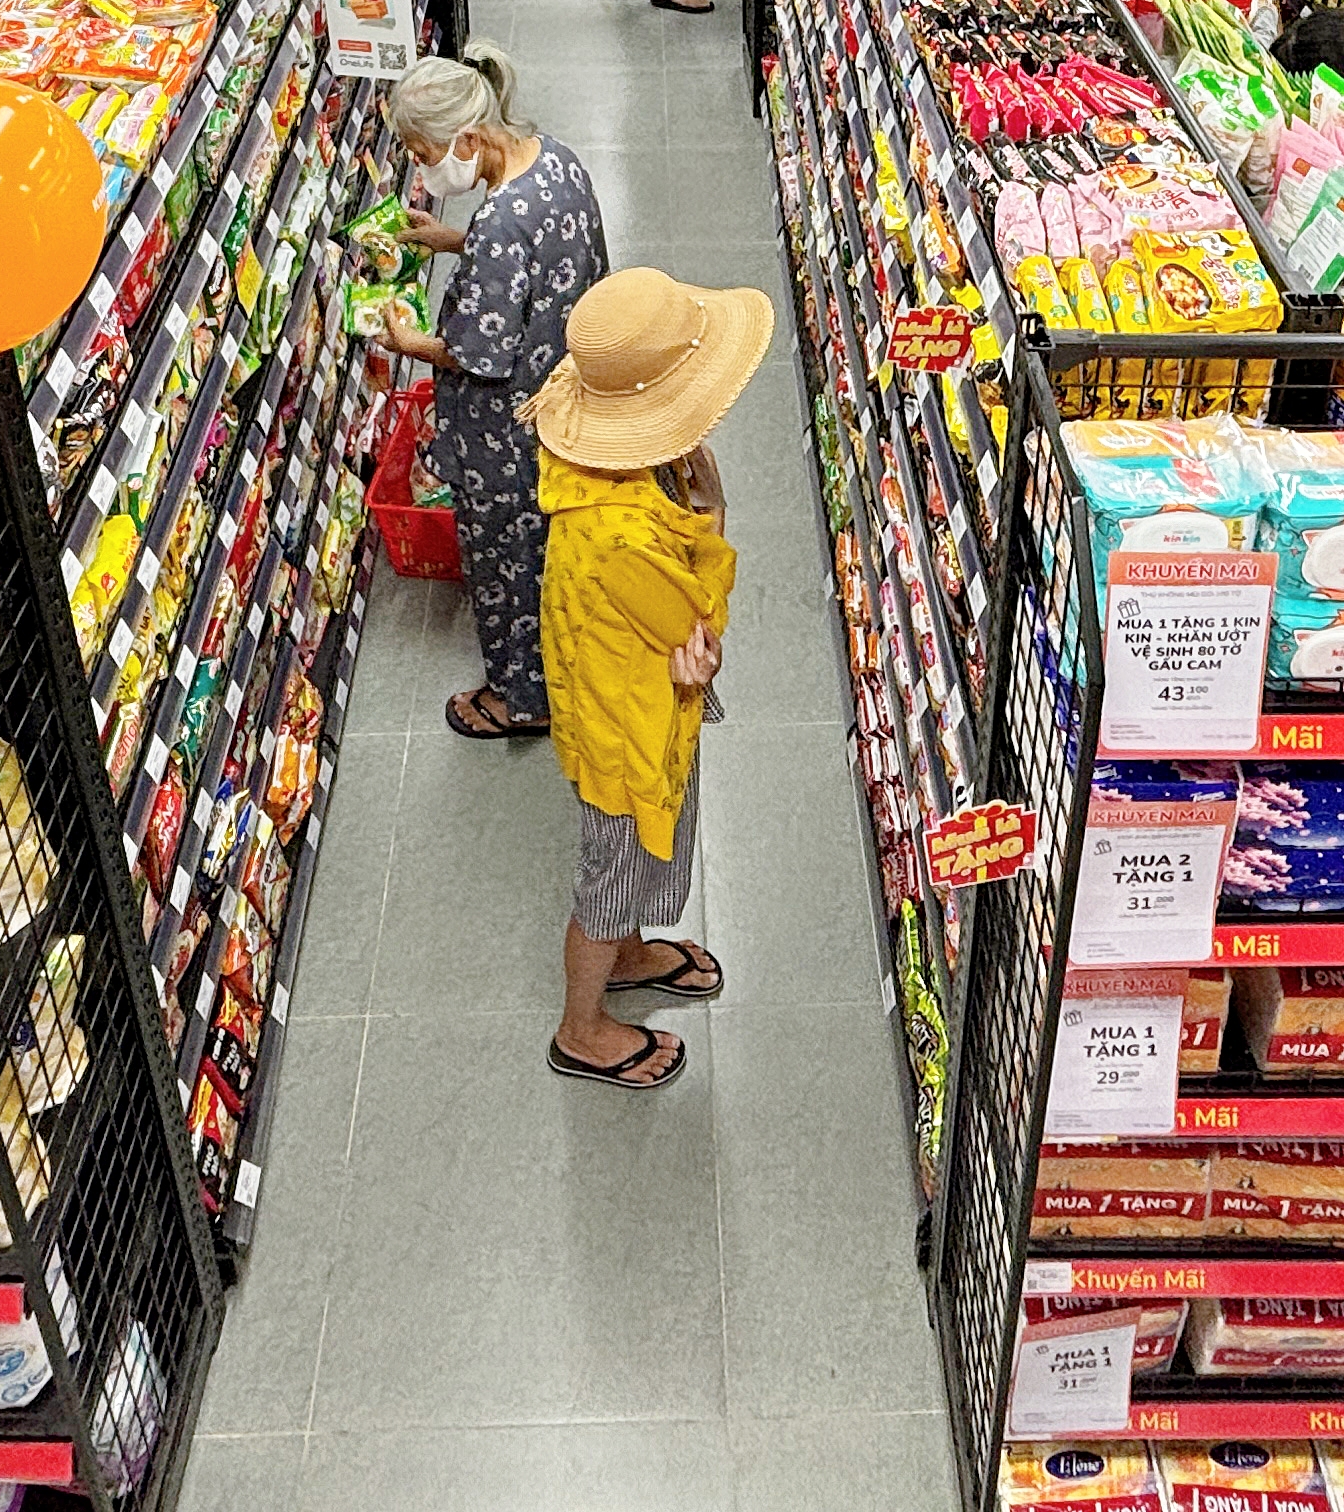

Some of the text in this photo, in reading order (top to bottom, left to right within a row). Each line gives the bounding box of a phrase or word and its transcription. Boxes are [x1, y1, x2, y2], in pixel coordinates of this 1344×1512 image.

[1126, 559, 1259, 582] KHUYẾN MÃI
[1117, 616, 1261, 632] MUA 1 TẶNG 1 KIN
[1124, 629, 1252, 644] KIN ƯỚT
[1130, 643, 1243, 659] VỆ SINH 80 TỜ
[1186, 659, 1222, 670] CAM
[1157, 685, 1186, 702] 43
[1120, 854, 1192, 867] MUA 2
[1113, 868, 1195, 886] TẶNG 1
[1127, 895, 1152, 911] 31
[1091, 1026, 1155, 1040] MUA 1
[1084, 1043, 1158, 1061] TẶNG 1
[1281, 1041, 1330, 1059] MUA
[1096, 1071, 1119, 1085] 29
[1045, 1193, 1194, 1216] MUA 1 TẶNG 1
